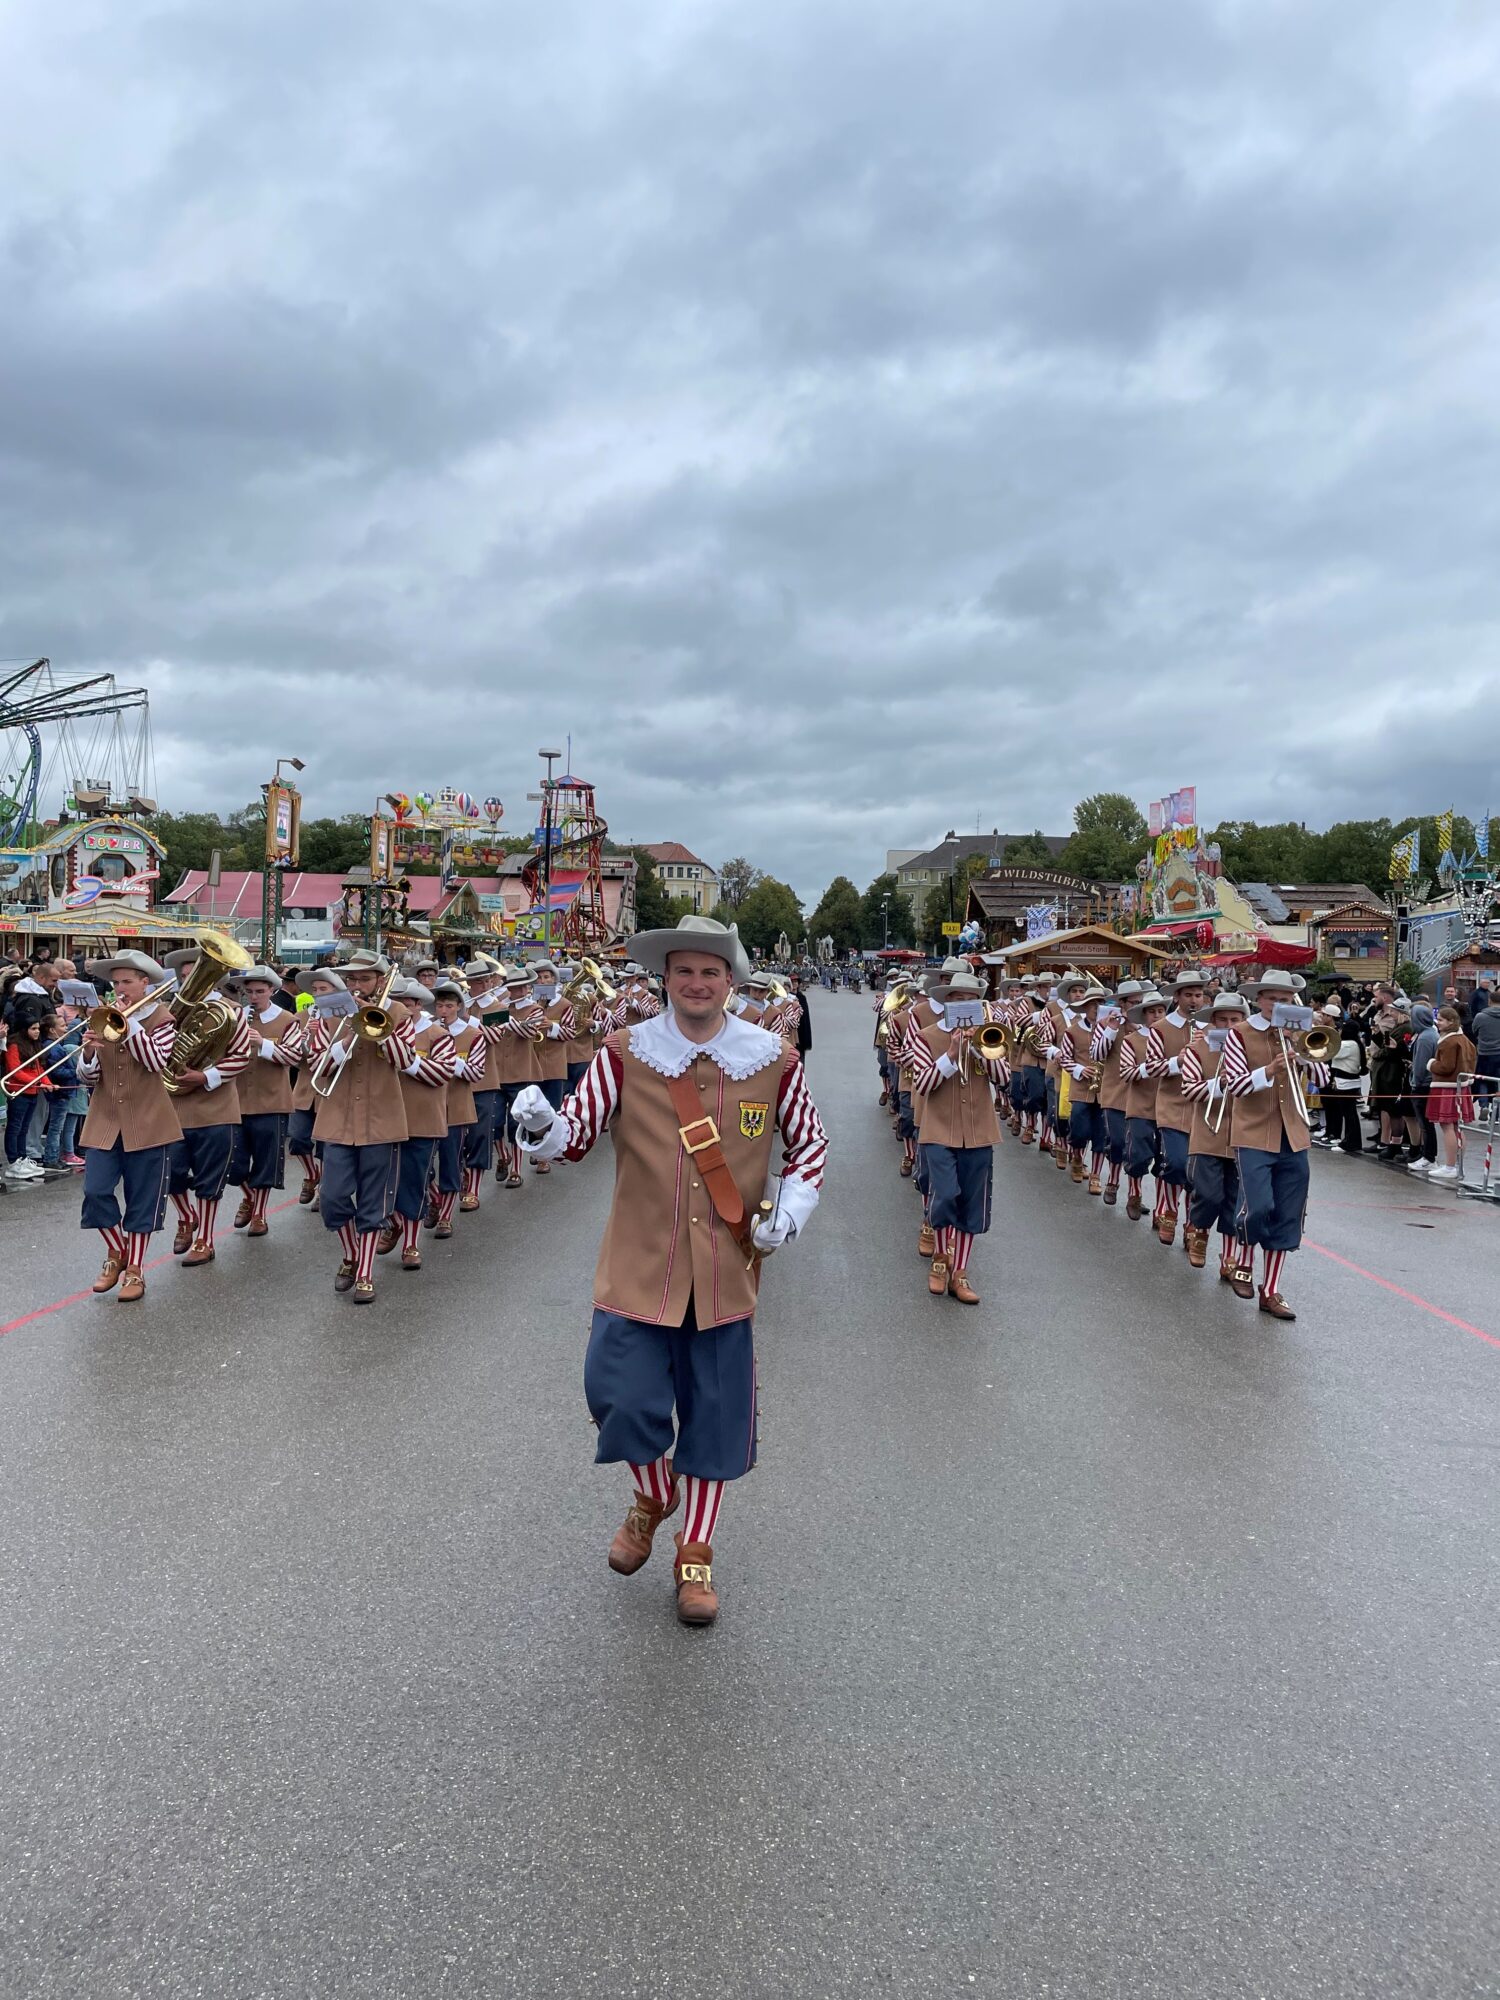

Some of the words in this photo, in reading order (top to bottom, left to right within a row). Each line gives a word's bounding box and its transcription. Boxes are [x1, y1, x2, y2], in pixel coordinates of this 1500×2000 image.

[87, 836, 141, 850] TOWER
[1003, 868, 1090, 892] WILDSTUBEN
[1087, 945, 1108, 953] Stand
